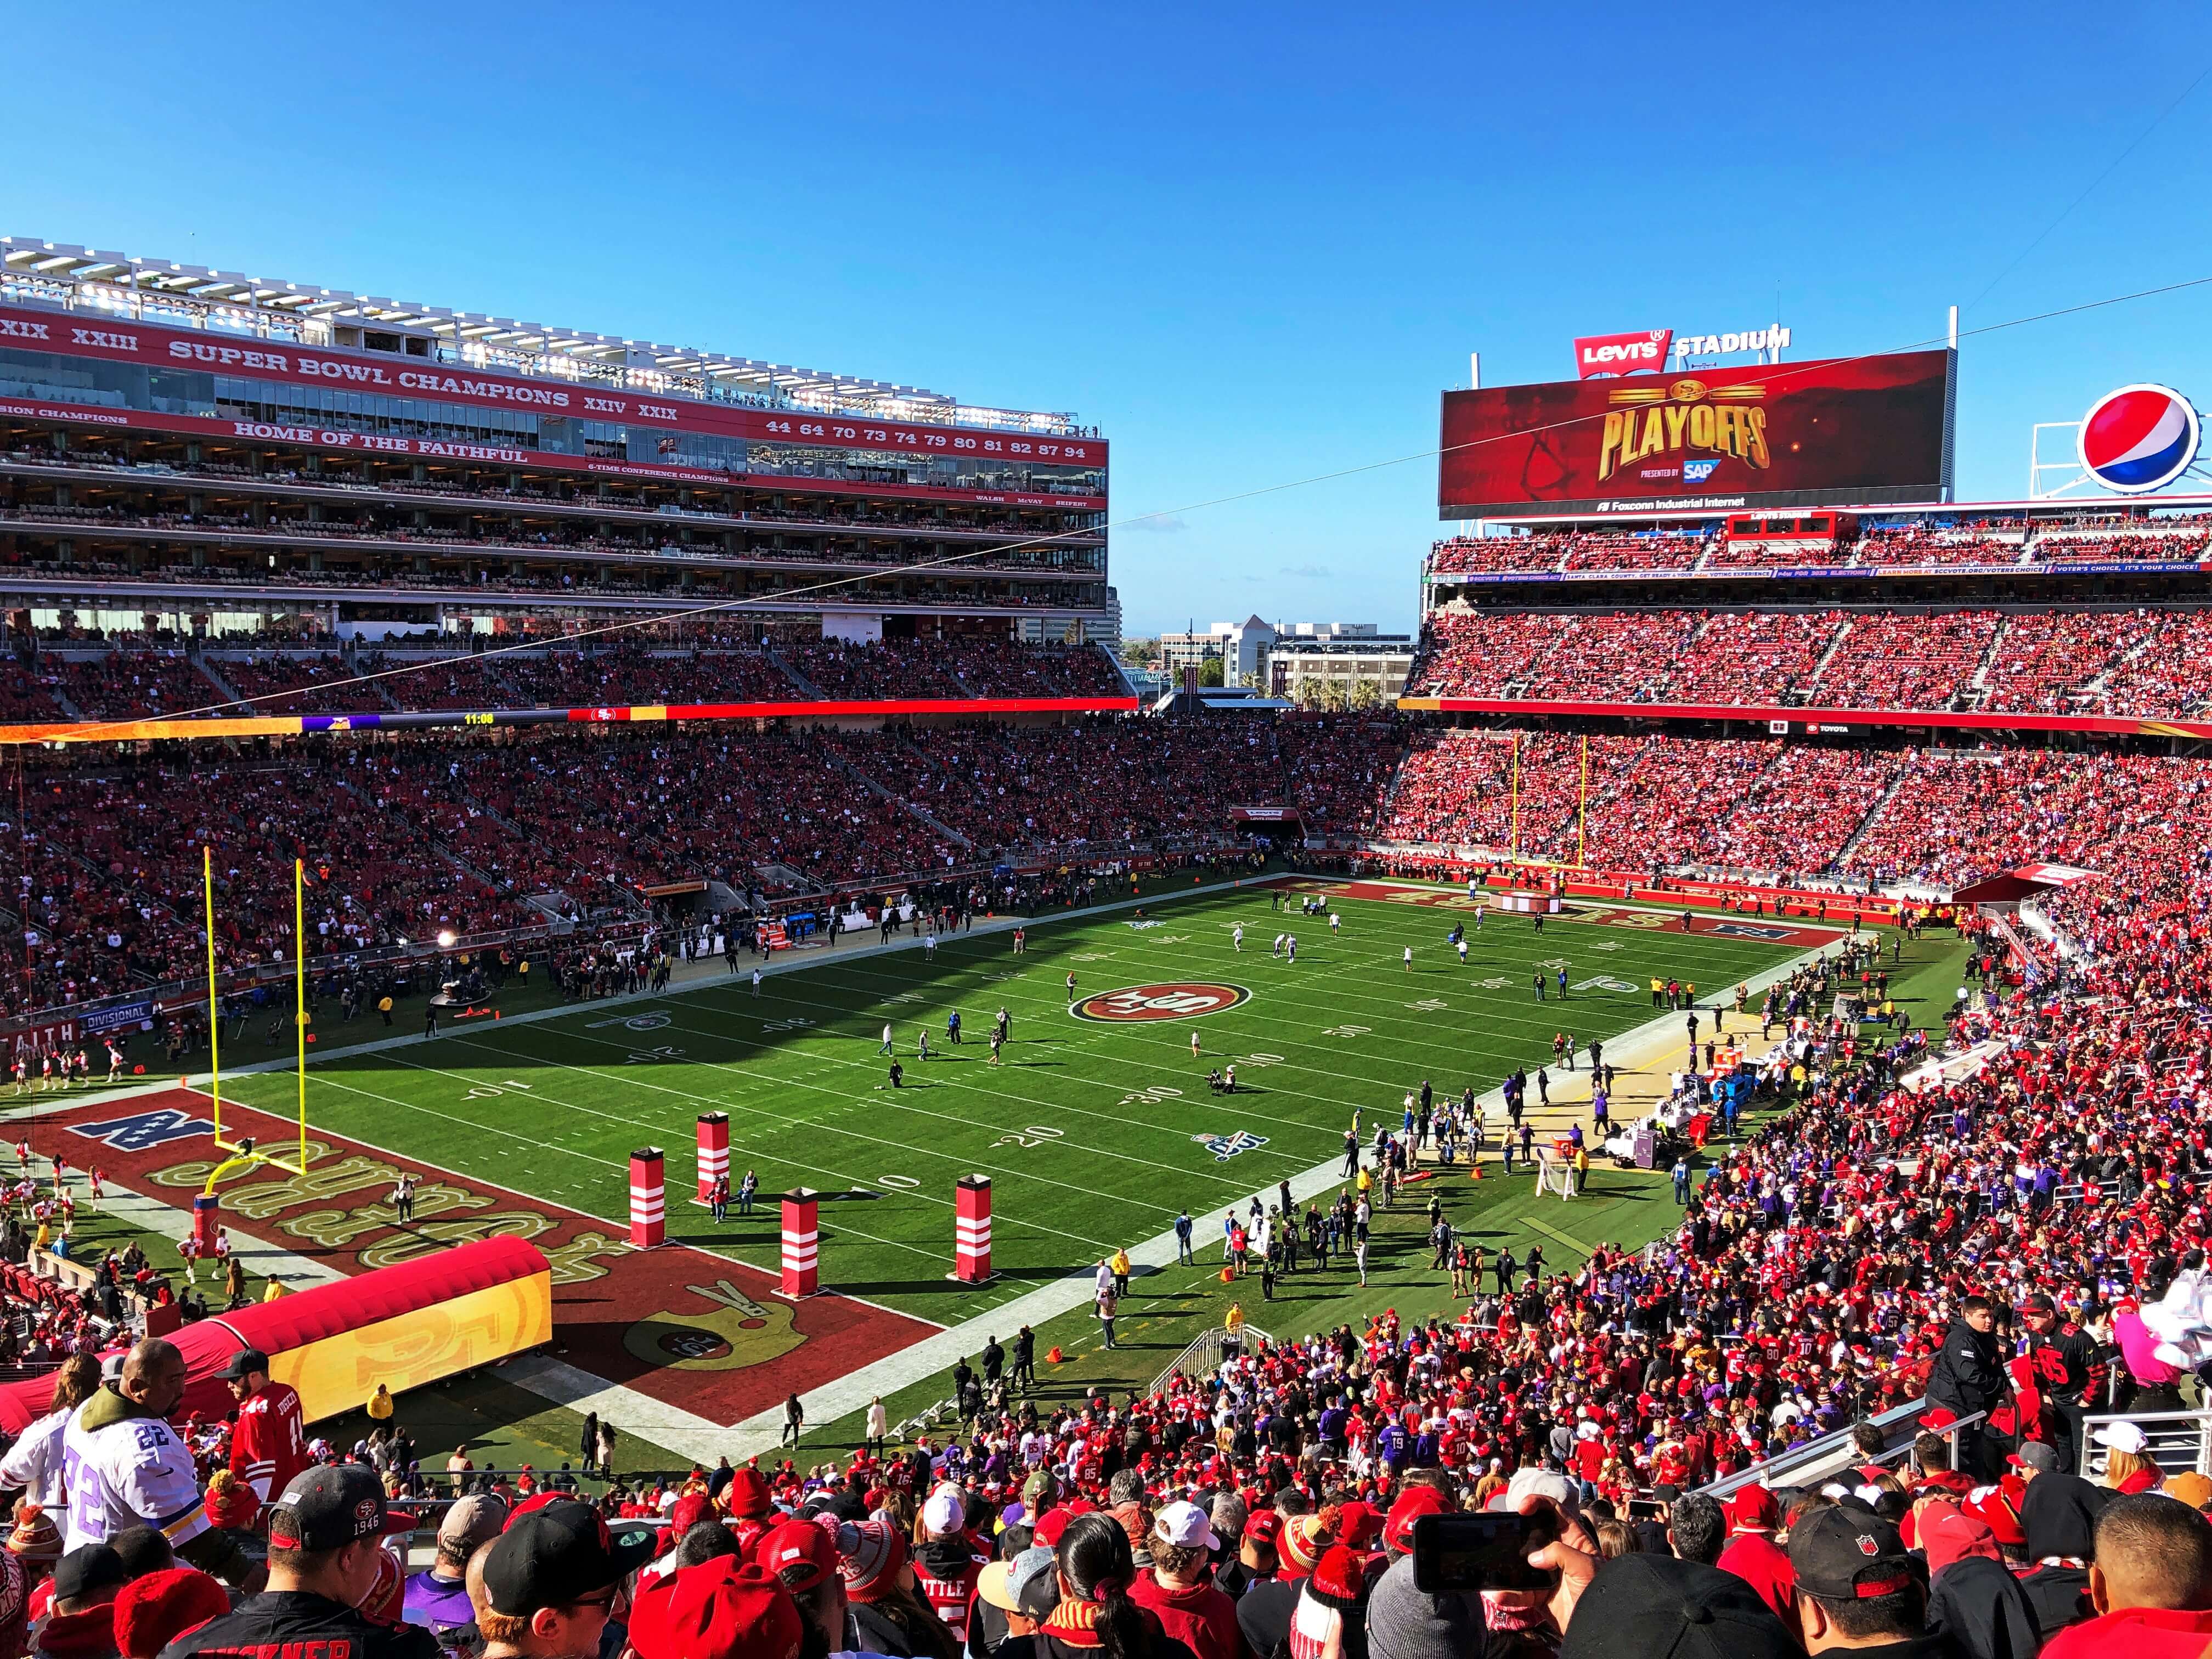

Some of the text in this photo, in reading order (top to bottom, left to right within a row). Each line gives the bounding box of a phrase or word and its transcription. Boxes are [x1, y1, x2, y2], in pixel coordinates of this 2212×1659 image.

[71, 329, 138, 351] XXIII
[1674, 328, 1791, 357] STADIUM
[169, 341, 570, 407] SUPER BOWL CHAMPIONS
[38, 409, 128, 424] CHAMPIONS
[584, 397, 678, 420] XXIV XXIX
[234, 422, 528, 462] HOME OF THE FAITHFUL
[766, 421, 1086, 459] 44 64 70 73 74 79 80 81 82 87 94
[1598, 405, 1770, 482] PLAYOFFS
[588, 464, 729, 483] 6-TIME CONFERENCE CHAMPIONS
[1640, 464, 1713, 479] PRESENTED BY SAP
[1612, 501, 1655, 512] Foxconn
[1656, 498, 1703, 510] Industrial
[1705, 496, 1745, 507] Internet
[465, 713, 494, 725] 11:08
[87, 1006, 145, 1028] DIVISIONAL
[1235, 1053, 1285, 1068] 40
[1125, 1086, 1183, 1104] 30
[1000, 1126, 1065, 1148] 20
[1766, 1348, 1780, 1360] 80
[1799, 1342, 1812, 1355] 10
[2036, 1350, 2068, 1384] 85
[1647, 1402, 1666, 1418] 35
[133, 1425, 170, 1451] 22
[1392, 1437, 1404, 1449] 19
[1028, 1443, 1040, 1454] 85
[1456, 1442, 1467, 1454] 10
[896, 1473, 910, 1485] 16
[1084, 1468, 1097, 1480] 85
[354, 1514, 379, 1536] 1946
[919, 1578, 965, 1597] ITTLE
